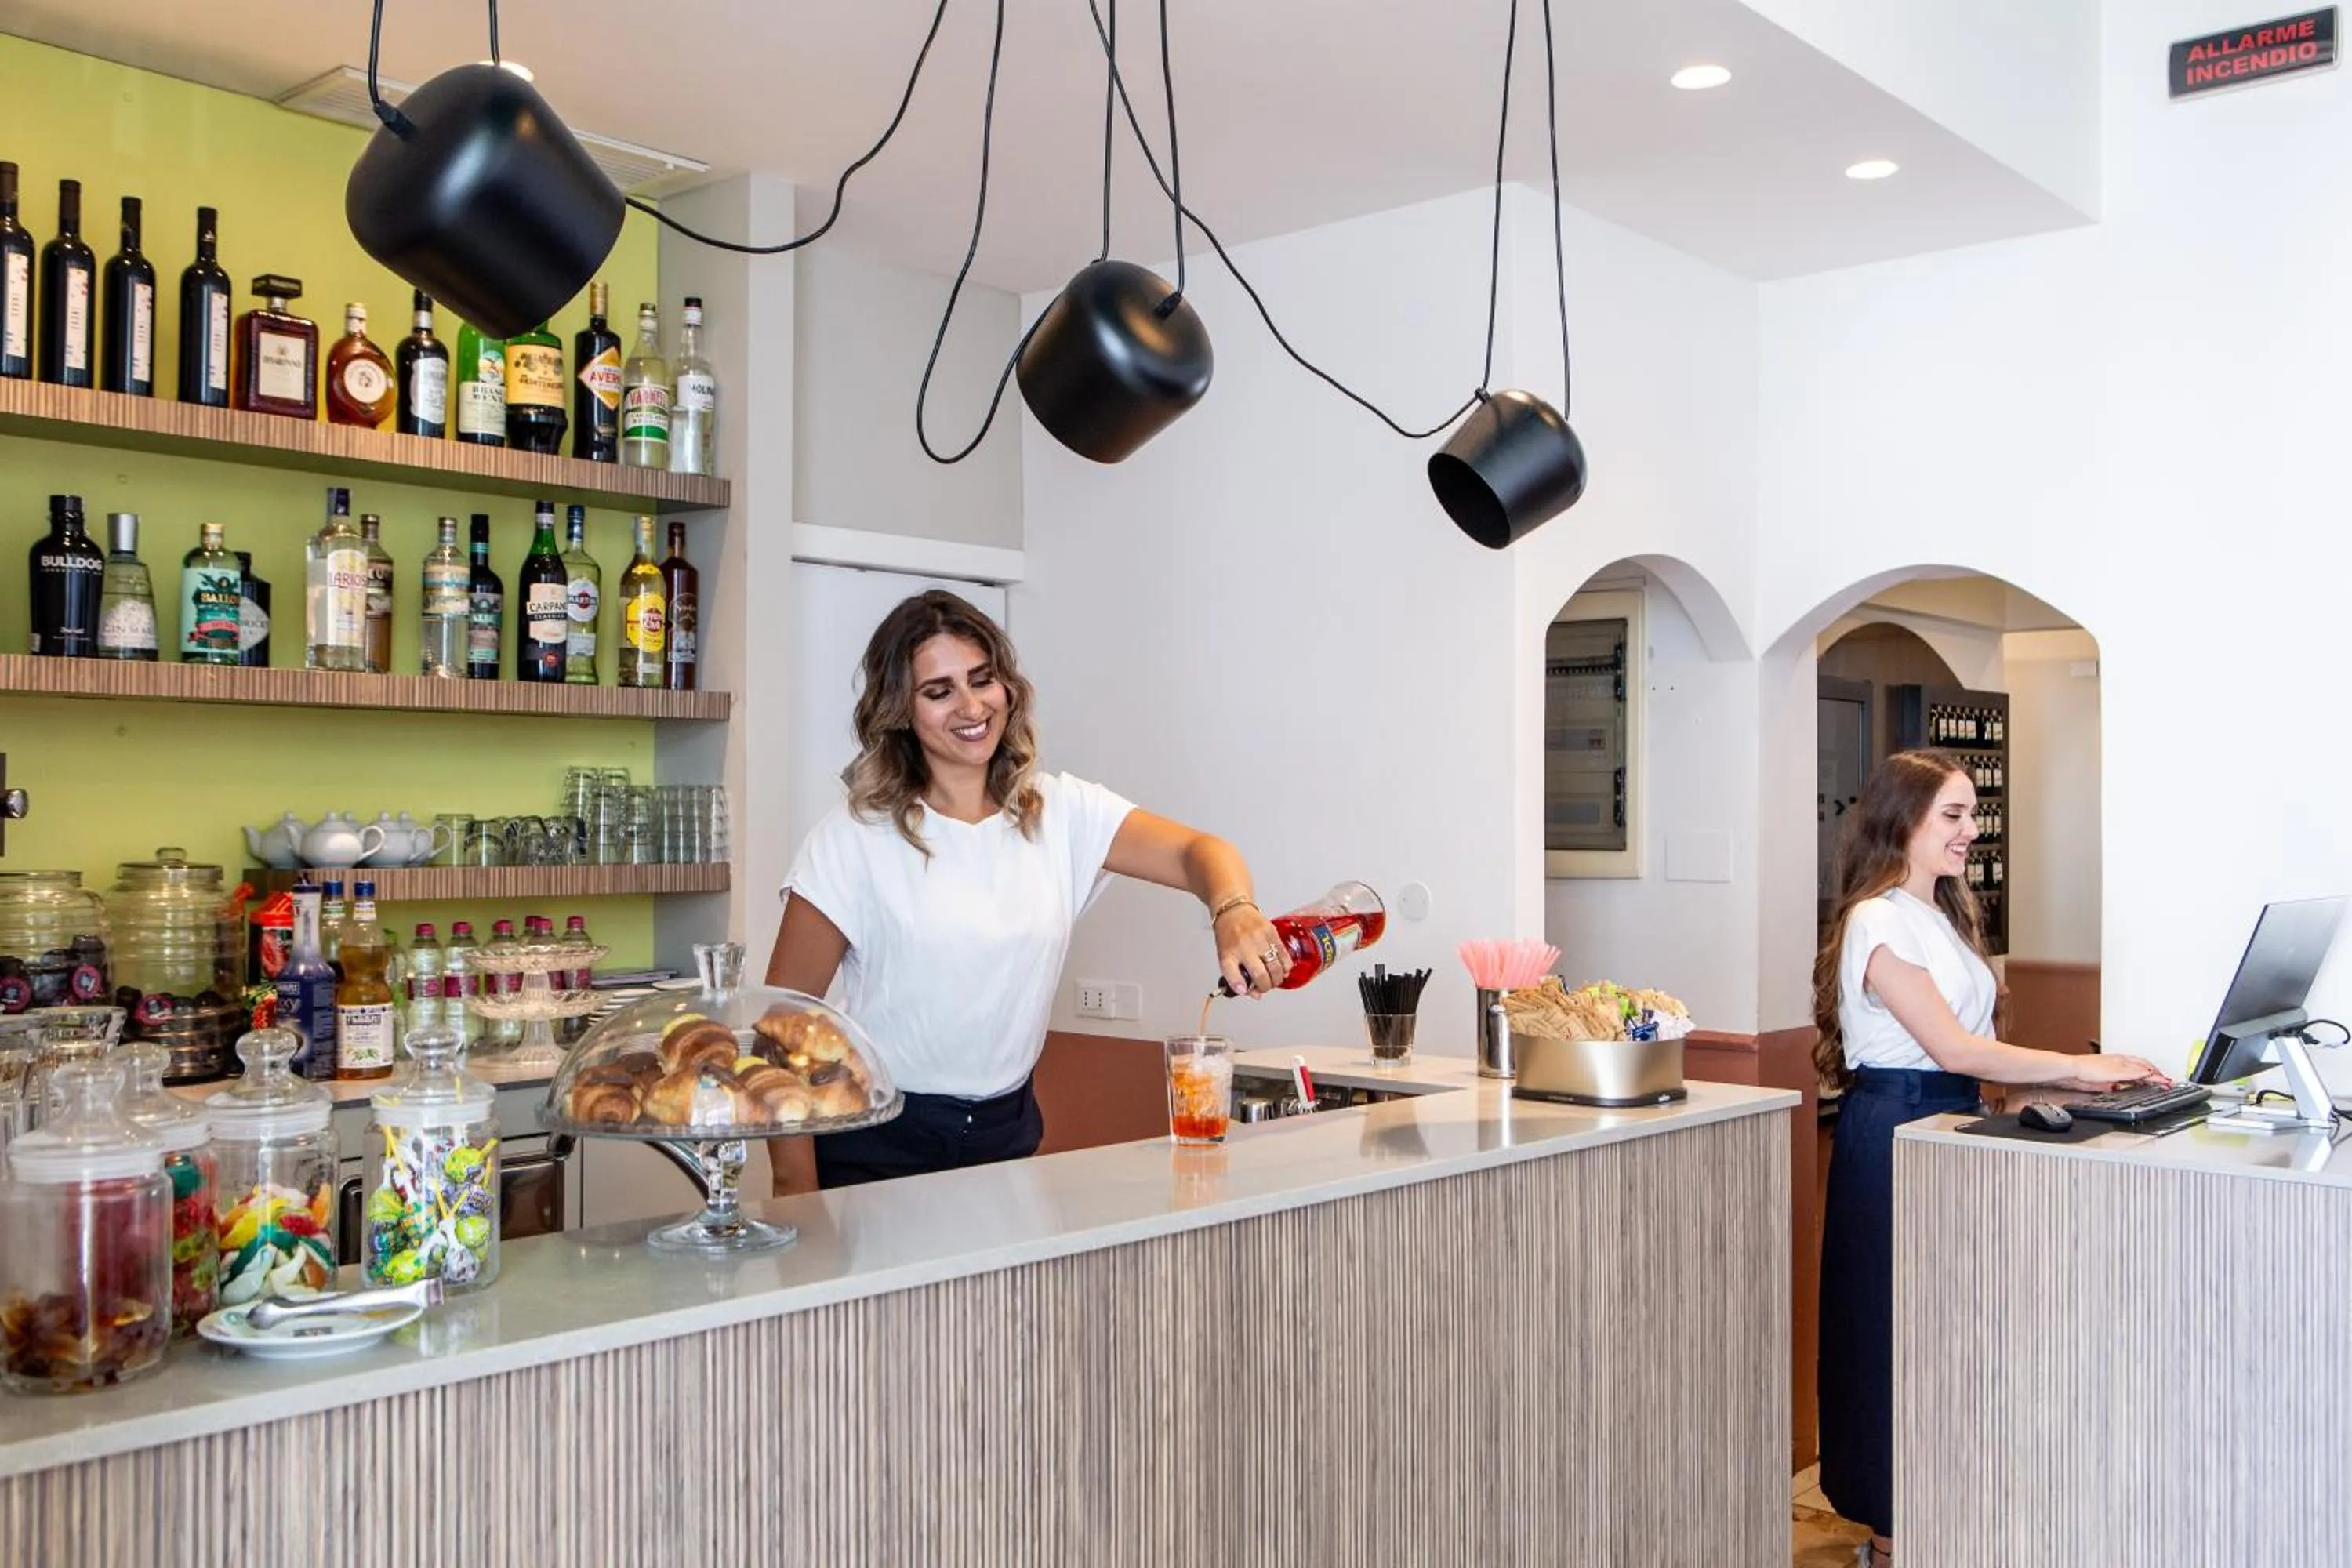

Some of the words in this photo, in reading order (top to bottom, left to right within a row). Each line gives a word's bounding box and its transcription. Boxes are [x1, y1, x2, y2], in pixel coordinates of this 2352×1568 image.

[2187, 19, 2316, 63] ALLARME
[2186, 42, 2318, 85] INCENDIO
[41, 554, 103, 570] BULLDOG
